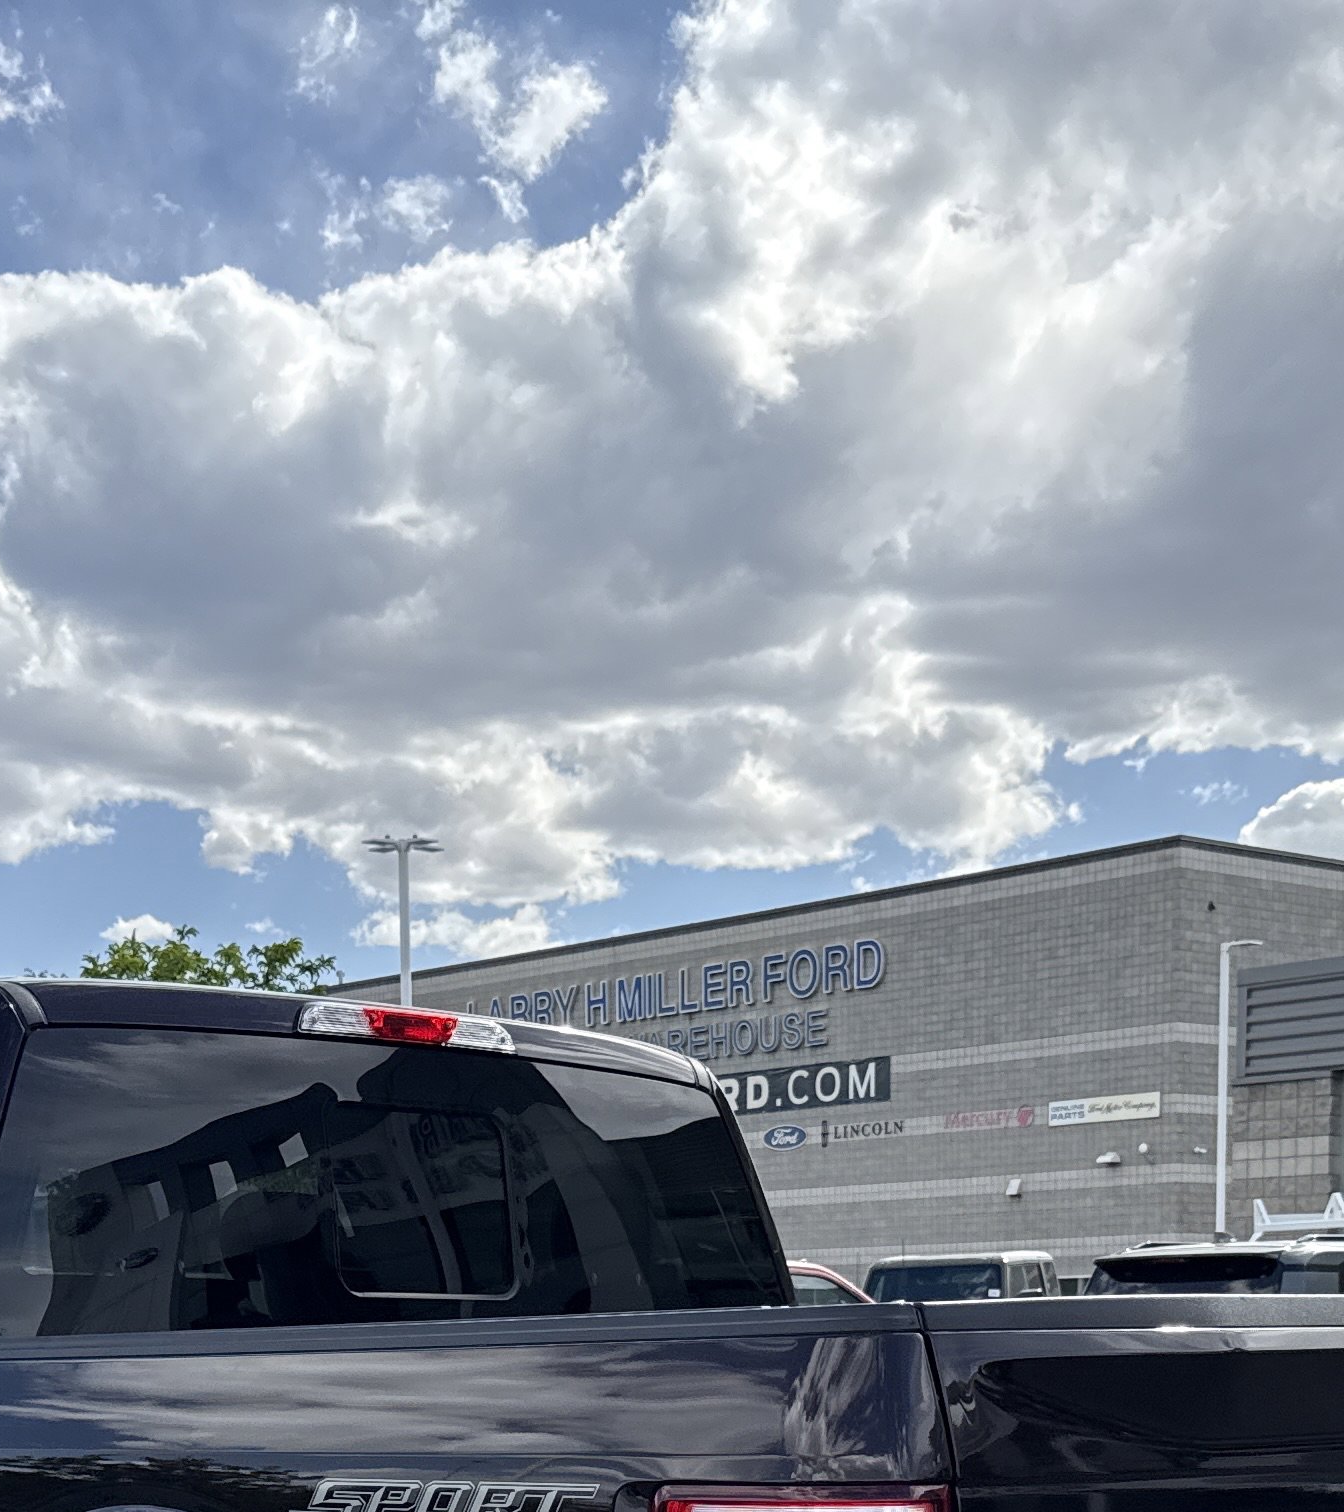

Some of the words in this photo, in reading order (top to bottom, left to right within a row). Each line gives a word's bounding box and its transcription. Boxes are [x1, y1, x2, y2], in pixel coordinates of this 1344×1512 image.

[584, 980, 609, 1027] H
[615, 960, 754, 1023] MILLER
[761, 938, 885, 1003] FORD
[629, 1009, 829, 1060] REHOUSE
[1050, 1111, 1085, 1120] PARTS
[770, 1128, 800, 1146] Ford
[833, 1119, 905, 1140] LINCOLN
